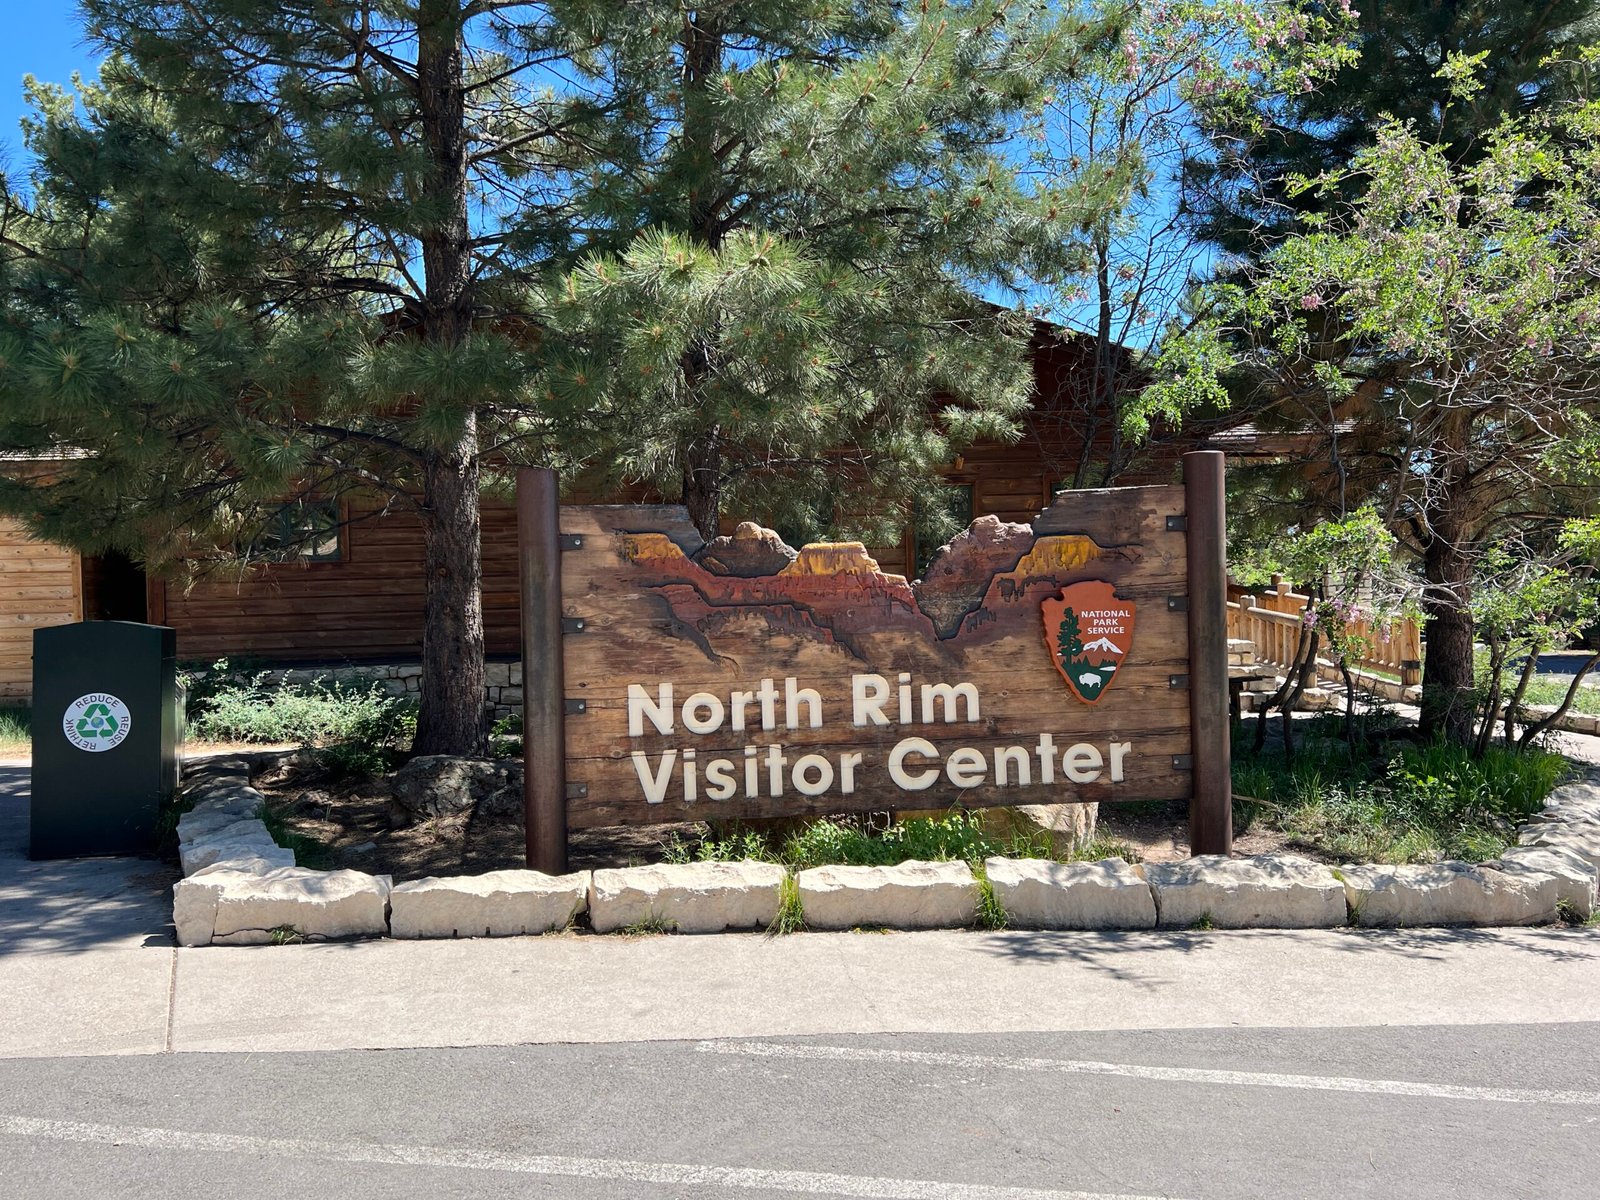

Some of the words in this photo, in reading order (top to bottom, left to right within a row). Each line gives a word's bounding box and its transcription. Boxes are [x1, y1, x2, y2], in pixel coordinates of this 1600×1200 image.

[1081, 610, 1131, 618] NATIONAL
[1093, 618, 1118, 626] PARK
[1087, 626, 1125, 635] SERVICE
[75, 694, 120, 709] REDUCE
[628, 677, 823, 737] North
[852, 672, 980, 727] Rim
[65, 718, 97, 750] RETHINK
[107, 716, 129, 746] REUSE
[631, 743, 862, 804] Visitor
[888, 733, 1132, 791] Center
